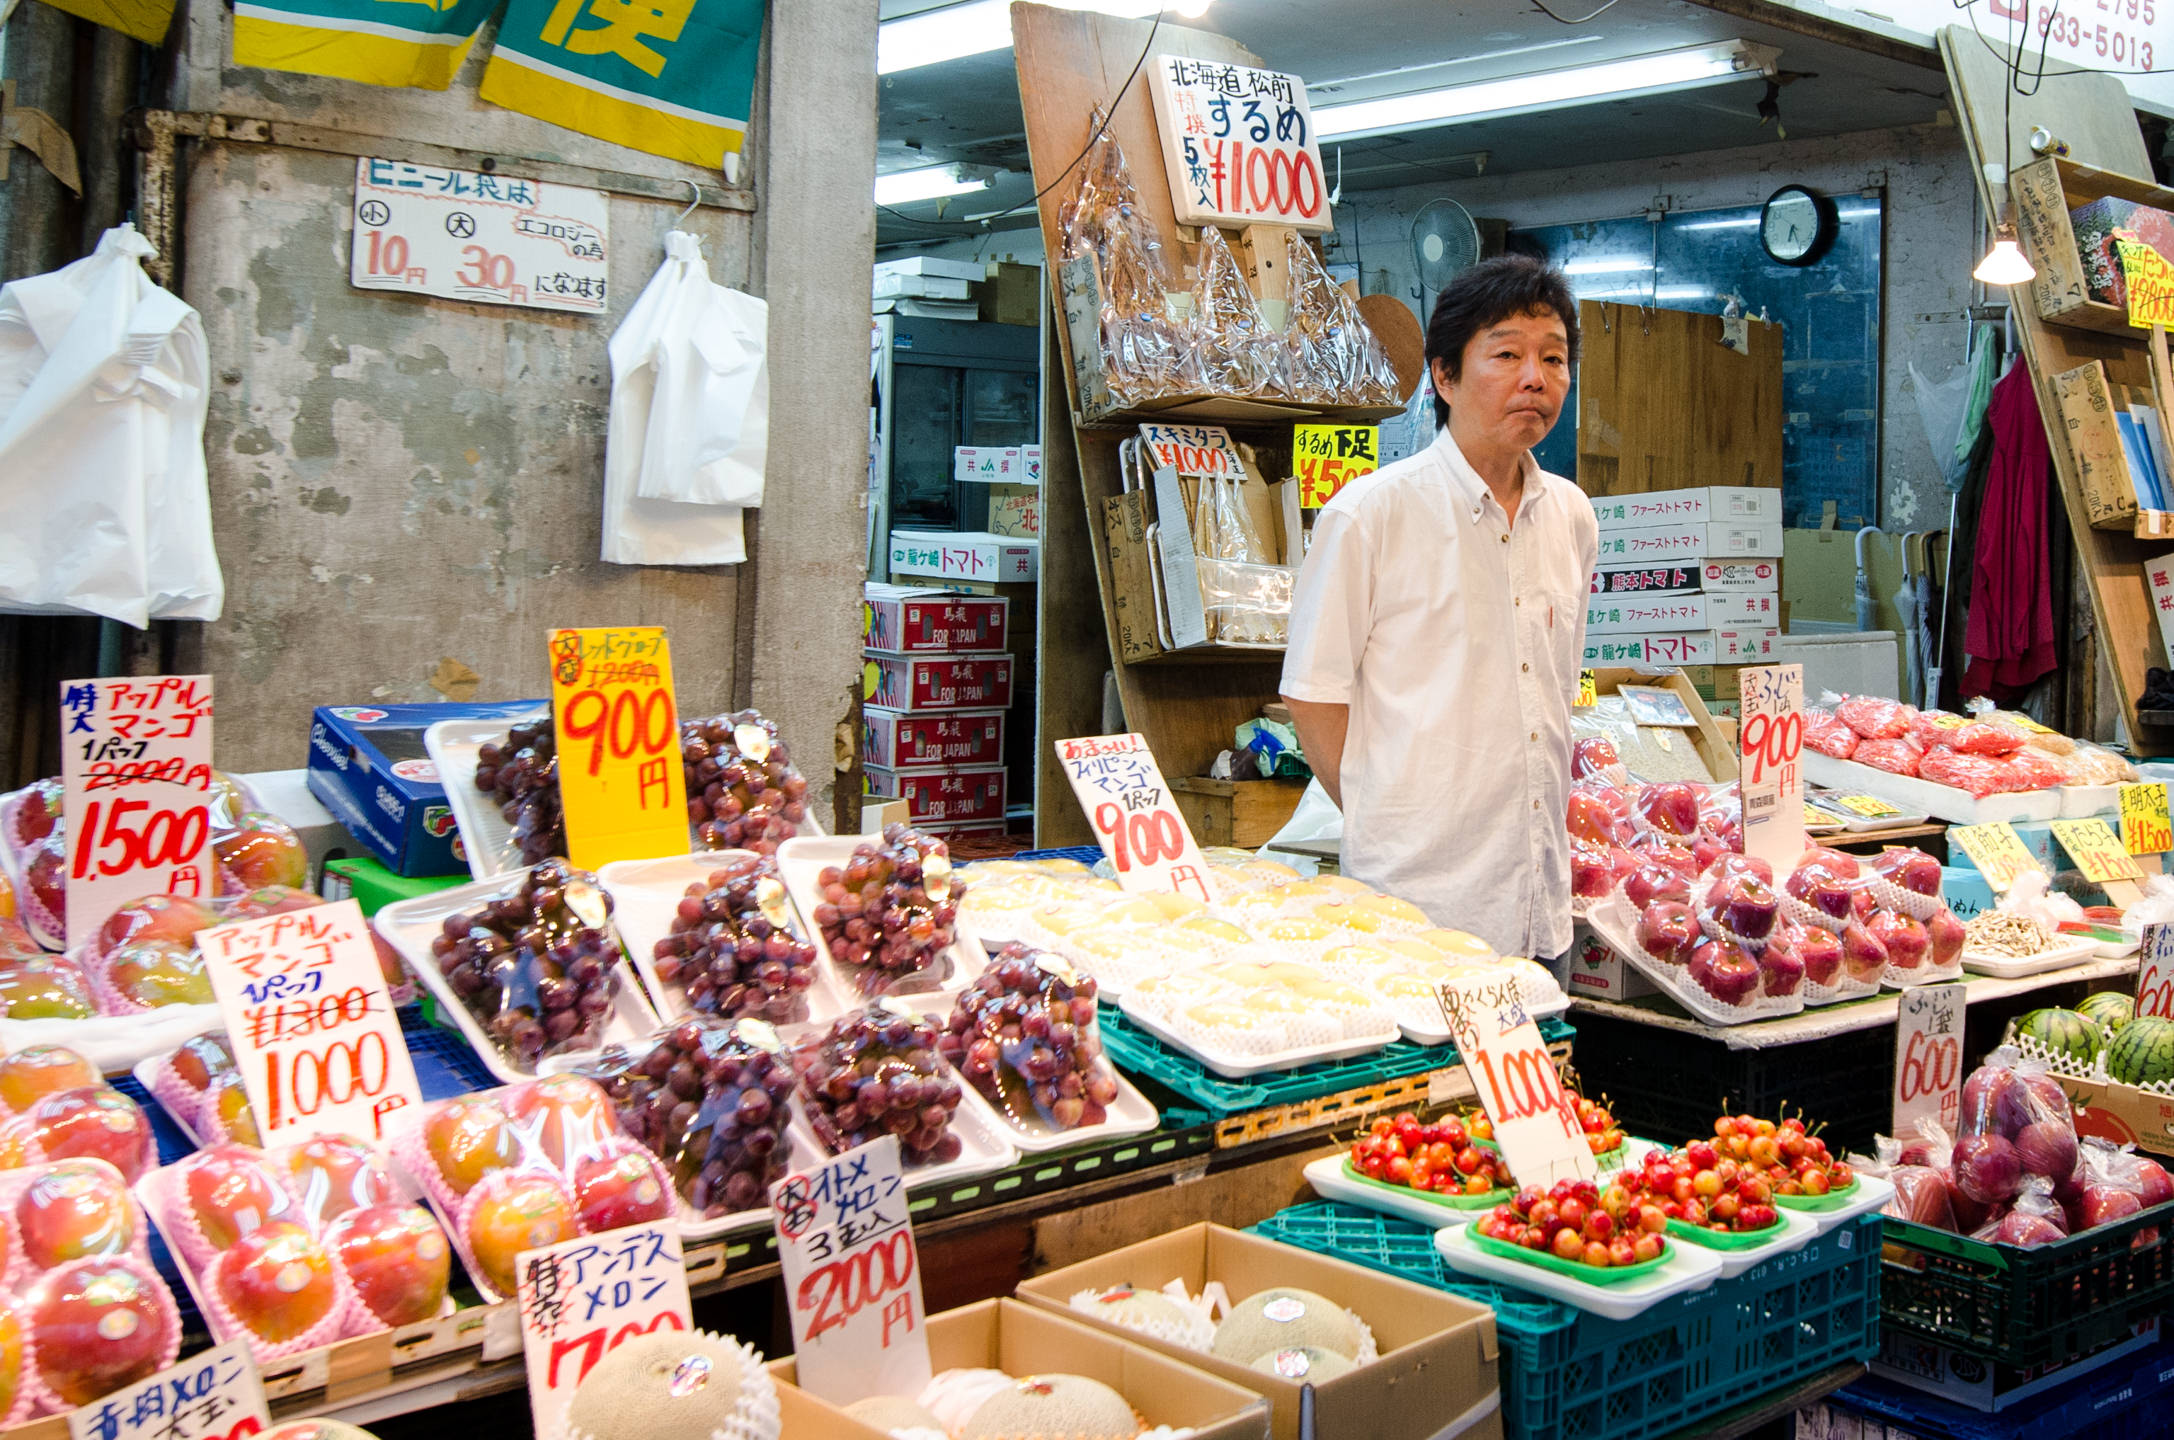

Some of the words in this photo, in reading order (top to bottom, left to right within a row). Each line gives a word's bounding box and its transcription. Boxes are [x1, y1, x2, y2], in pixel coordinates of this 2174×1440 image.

[2038, 6, 2153, 71] 833-5013
[1208, 95, 1306, 147] するめ
[362, 202, 387, 224] 小
[449, 214, 473, 236] 大
[1150, 426, 1226, 449] スキミタラ
[942, 546, 984, 575] トマト
[1611, 568, 1687, 593] 熊本トマト
[932, 629, 948, 643] FOR
[1644, 636, 1697, 663] トマト
[940, 687, 956, 702] FOR
[1759, 669, 1796, 704] ふじ
[564, 688, 675, 777] 900
[926, 744, 943, 759] FOR
[1742, 711, 1802, 783] 900
[639, 756, 669, 810] 円
[1779, 763, 1796, 798] 円
[2129, 783, 2166, 813] 明太子
[929, 801, 946, 818] FOR
[1095, 802, 1184, 872] 900
[169, 866, 200, 898] 円
[1171, 865, 1211, 903] 円
[211, 914, 333, 957] アップル
[1901, 1029, 1959, 1103] 600
[373, 1094, 408, 1140] 円
[1556, 1100, 1580, 1139] 円
[1939, 1089, 1958, 1127] 円
[836, 1176, 901, 1225] メロン
[563, 1229, 680, 1284] アンデス
[585, 1277, 668, 1321] メロン
[881, 1291, 914, 1349] 円
